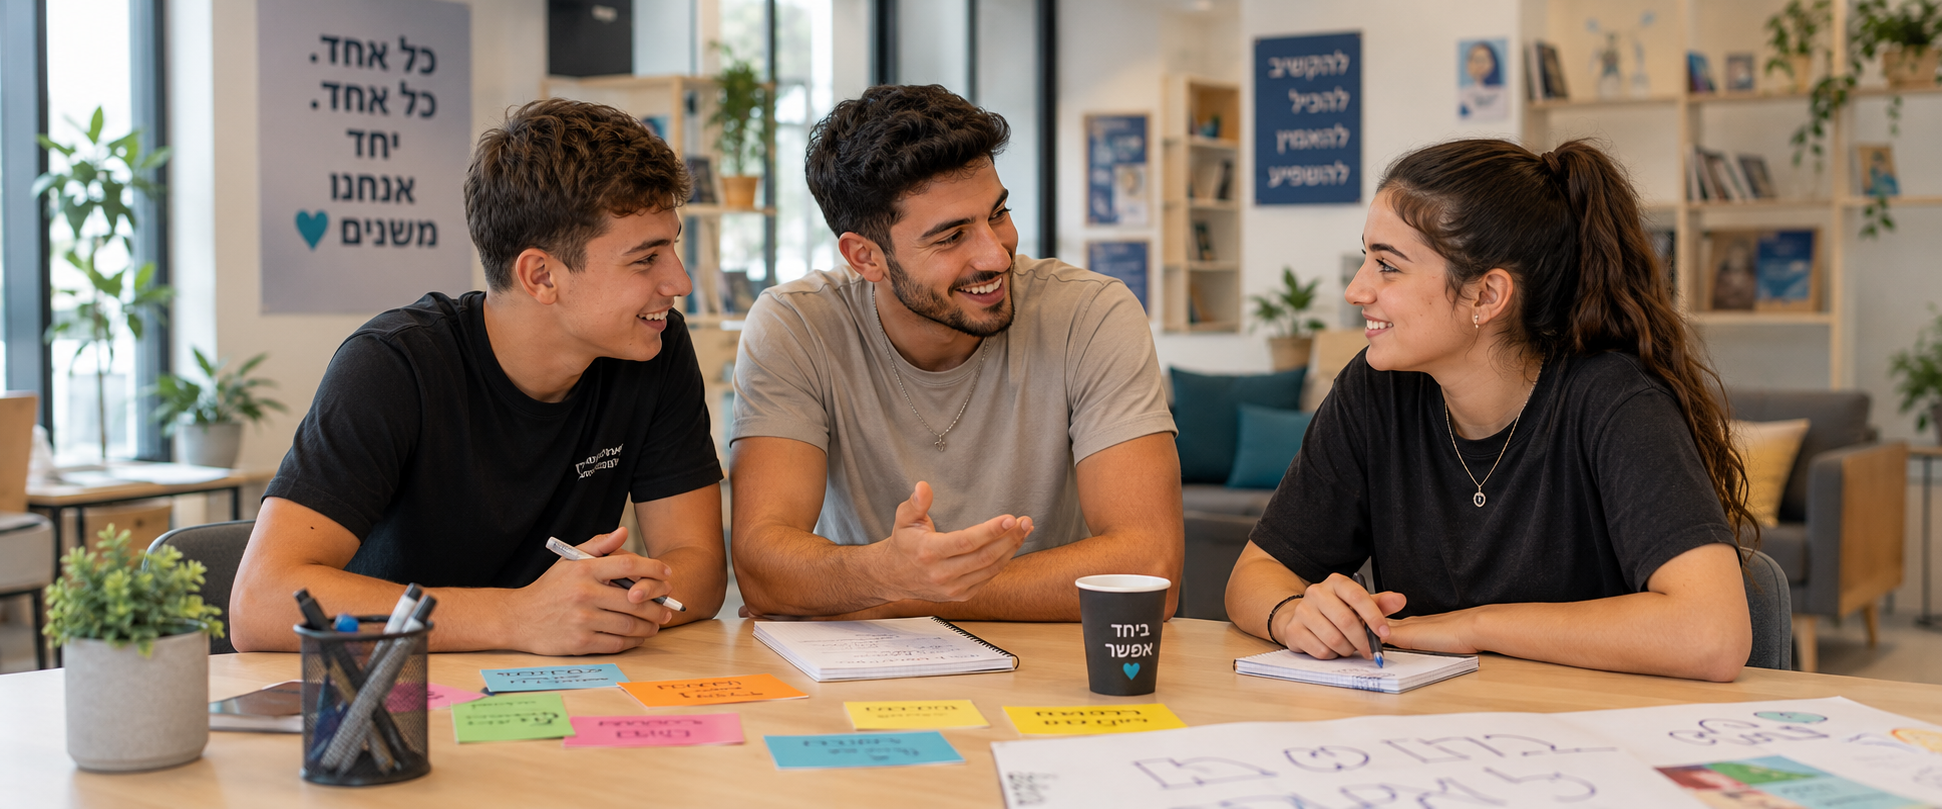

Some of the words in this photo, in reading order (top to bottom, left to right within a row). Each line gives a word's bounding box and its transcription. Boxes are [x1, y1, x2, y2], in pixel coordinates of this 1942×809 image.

[309, 34, 389, 71] אחד.
[397, 35, 437, 75] כל
[1267, 49, 1350, 81] להקשיב
[309, 80, 390, 116] אחד.
[397, 79, 437, 119] כל
[1288, 85, 1350, 114] להכיל
[346, 128, 400, 158] יחד
[1275, 122, 1350, 155] להאמין
[329, 172, 416, 204] אנחנו
[1267, 159, 1350, 189] להשפיע
[340, 217, 438, 247] משנים
[1110, 623, 1150, 638] ביחד
[1105, 642, 1153, 658] אפשר
